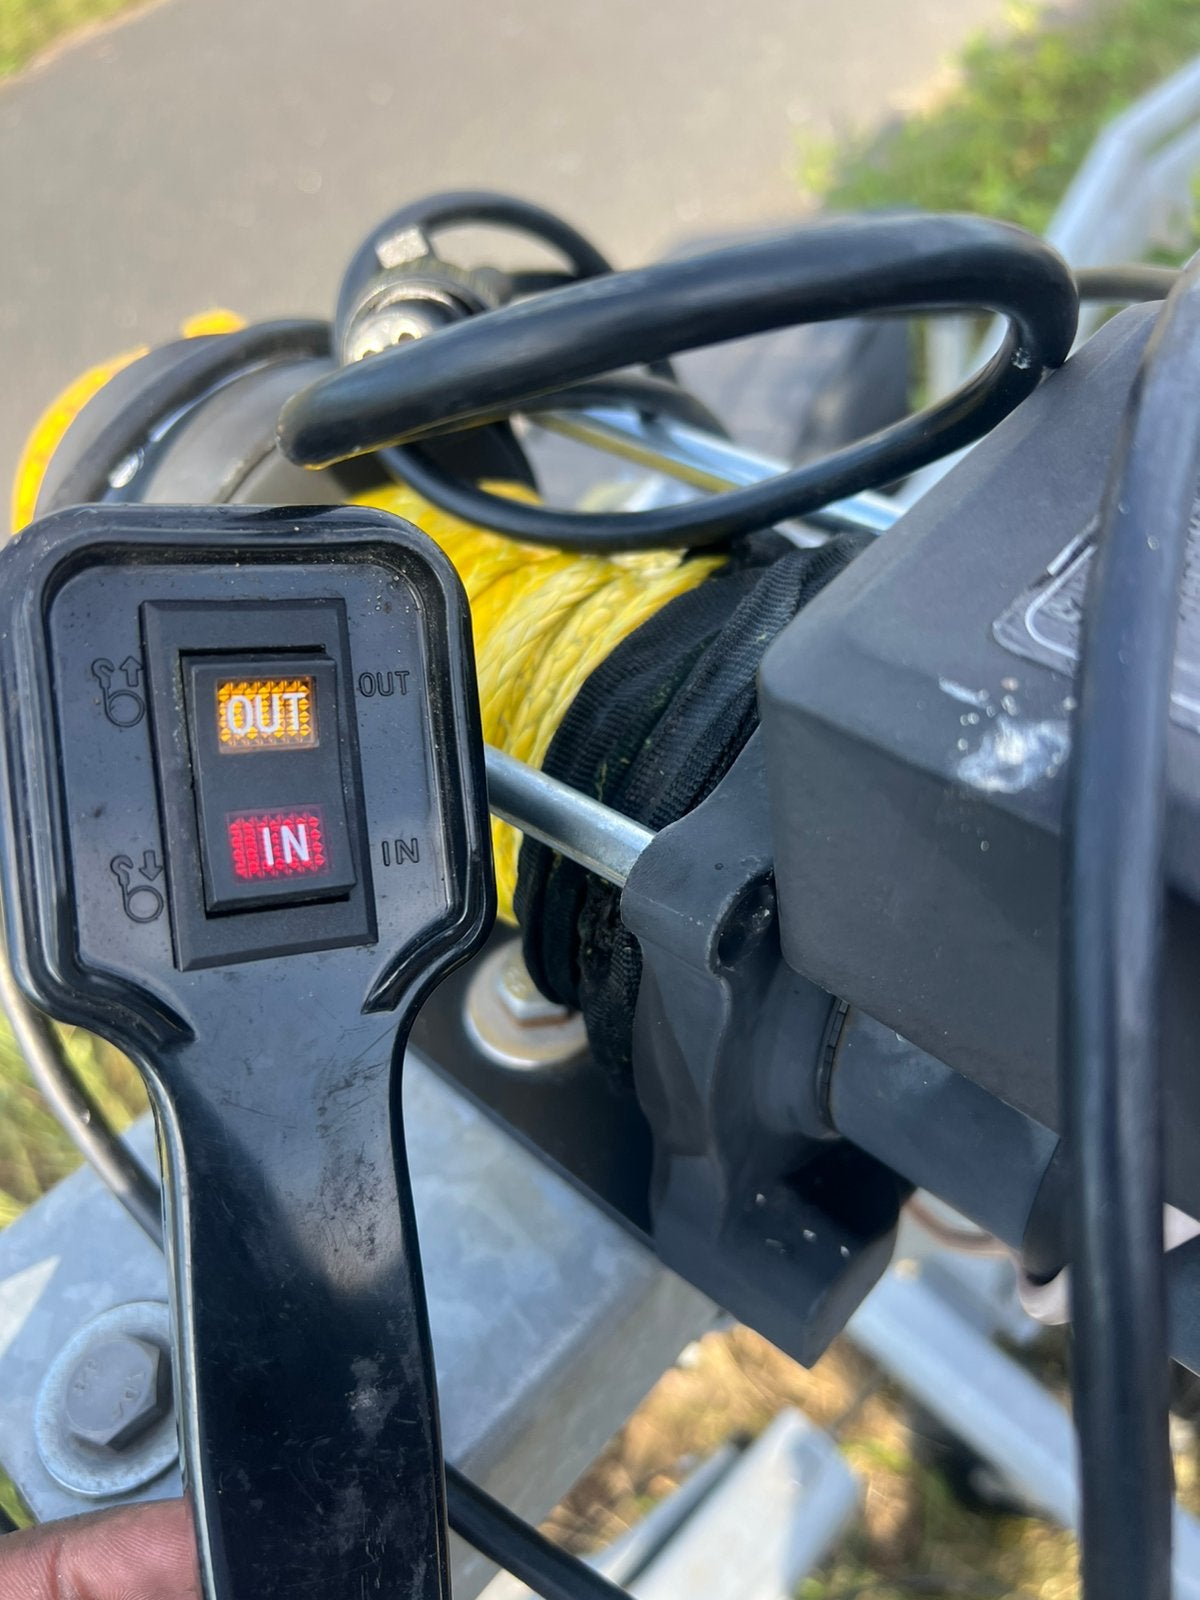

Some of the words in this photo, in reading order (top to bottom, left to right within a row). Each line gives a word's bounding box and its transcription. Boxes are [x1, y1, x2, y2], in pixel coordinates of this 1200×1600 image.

[359, 671, 410, 697] OUT
[227, 692, 306, 734] OUT
[262, 823, 310, 866] IN
[381, 838, 420, 866] IN
